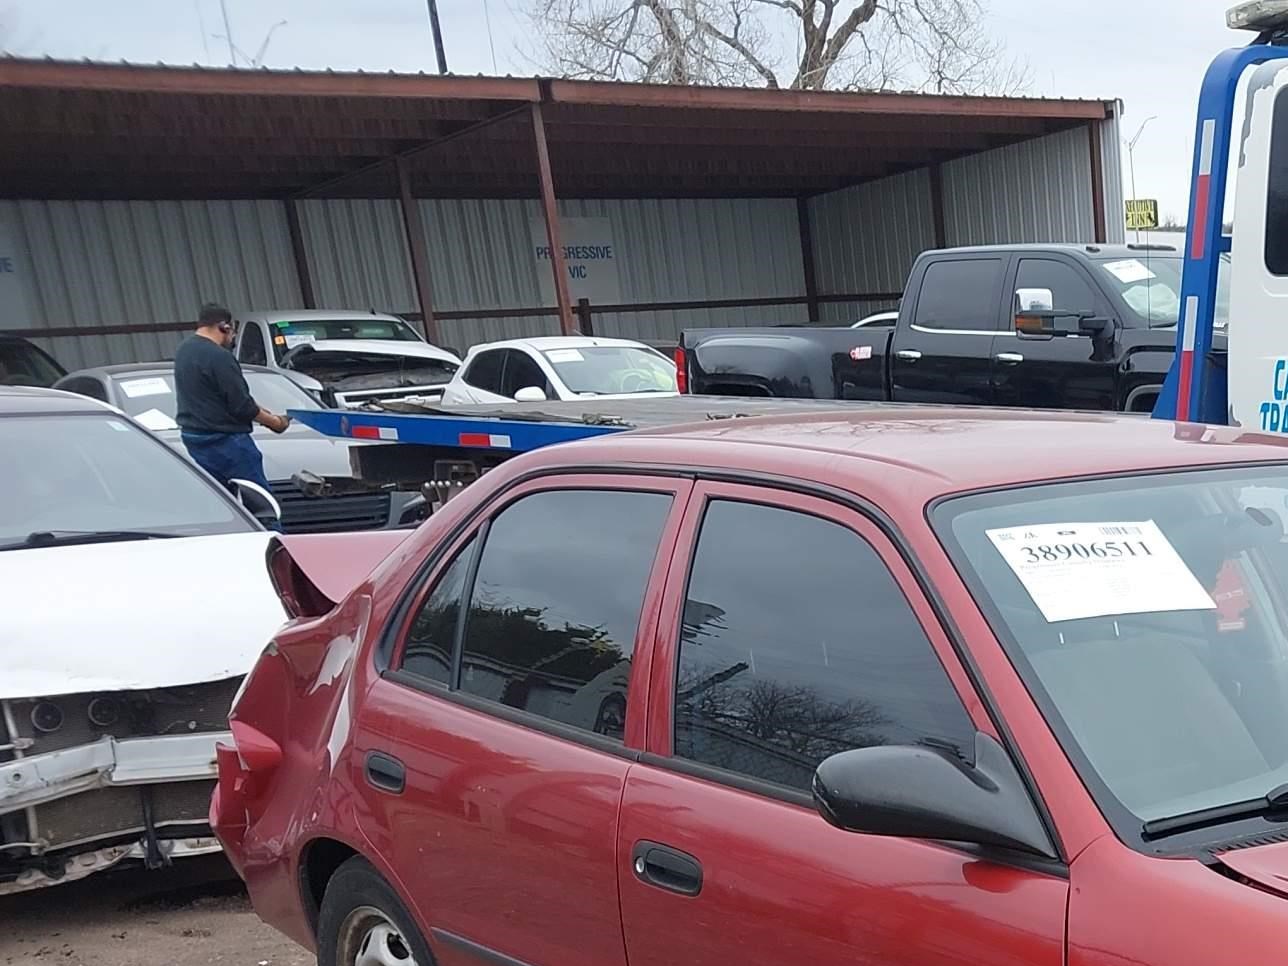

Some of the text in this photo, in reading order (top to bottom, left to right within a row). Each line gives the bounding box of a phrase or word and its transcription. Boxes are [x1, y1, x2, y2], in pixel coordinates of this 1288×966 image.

[536, 246, 612, 259] PRGRESSIVE
[568, 266, 587, 279] VIC
[1020, 540, 1153, 564] 38906511
